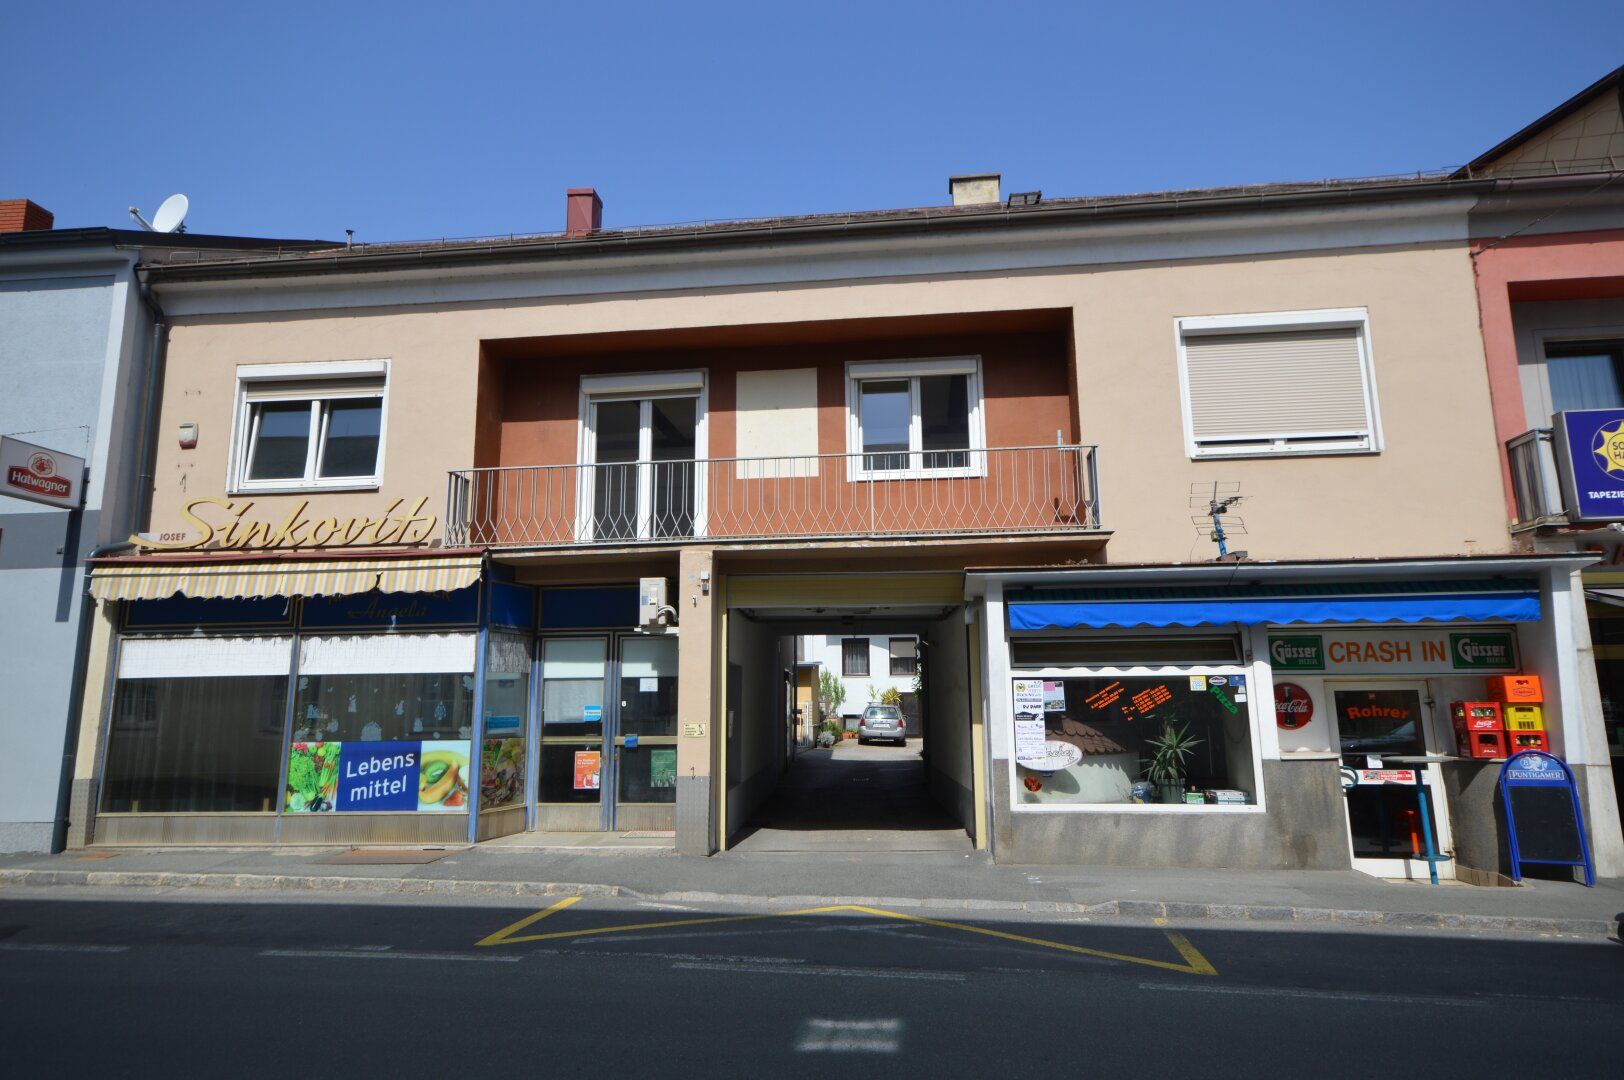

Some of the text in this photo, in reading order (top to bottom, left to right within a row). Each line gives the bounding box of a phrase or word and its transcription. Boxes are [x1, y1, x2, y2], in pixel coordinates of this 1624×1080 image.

[12, 470, 68, 493] Hatwagner
[158, 532, 186, 541] JOSEF
[1271, 640, 1317, 665] Gösser
[1328, 640, 1446, 663] CRASH IN
[1457, 638, 1506, 663] Gösser
[1210, 685, 1238, 715] Pizza
[1346, 705, 1409, 720] Rohrer
[346, 753, 415, 778] Lebens
[1512, 770, 1561, 779] PUNTIGAMER
[350, 774, 407, 802] mittel
